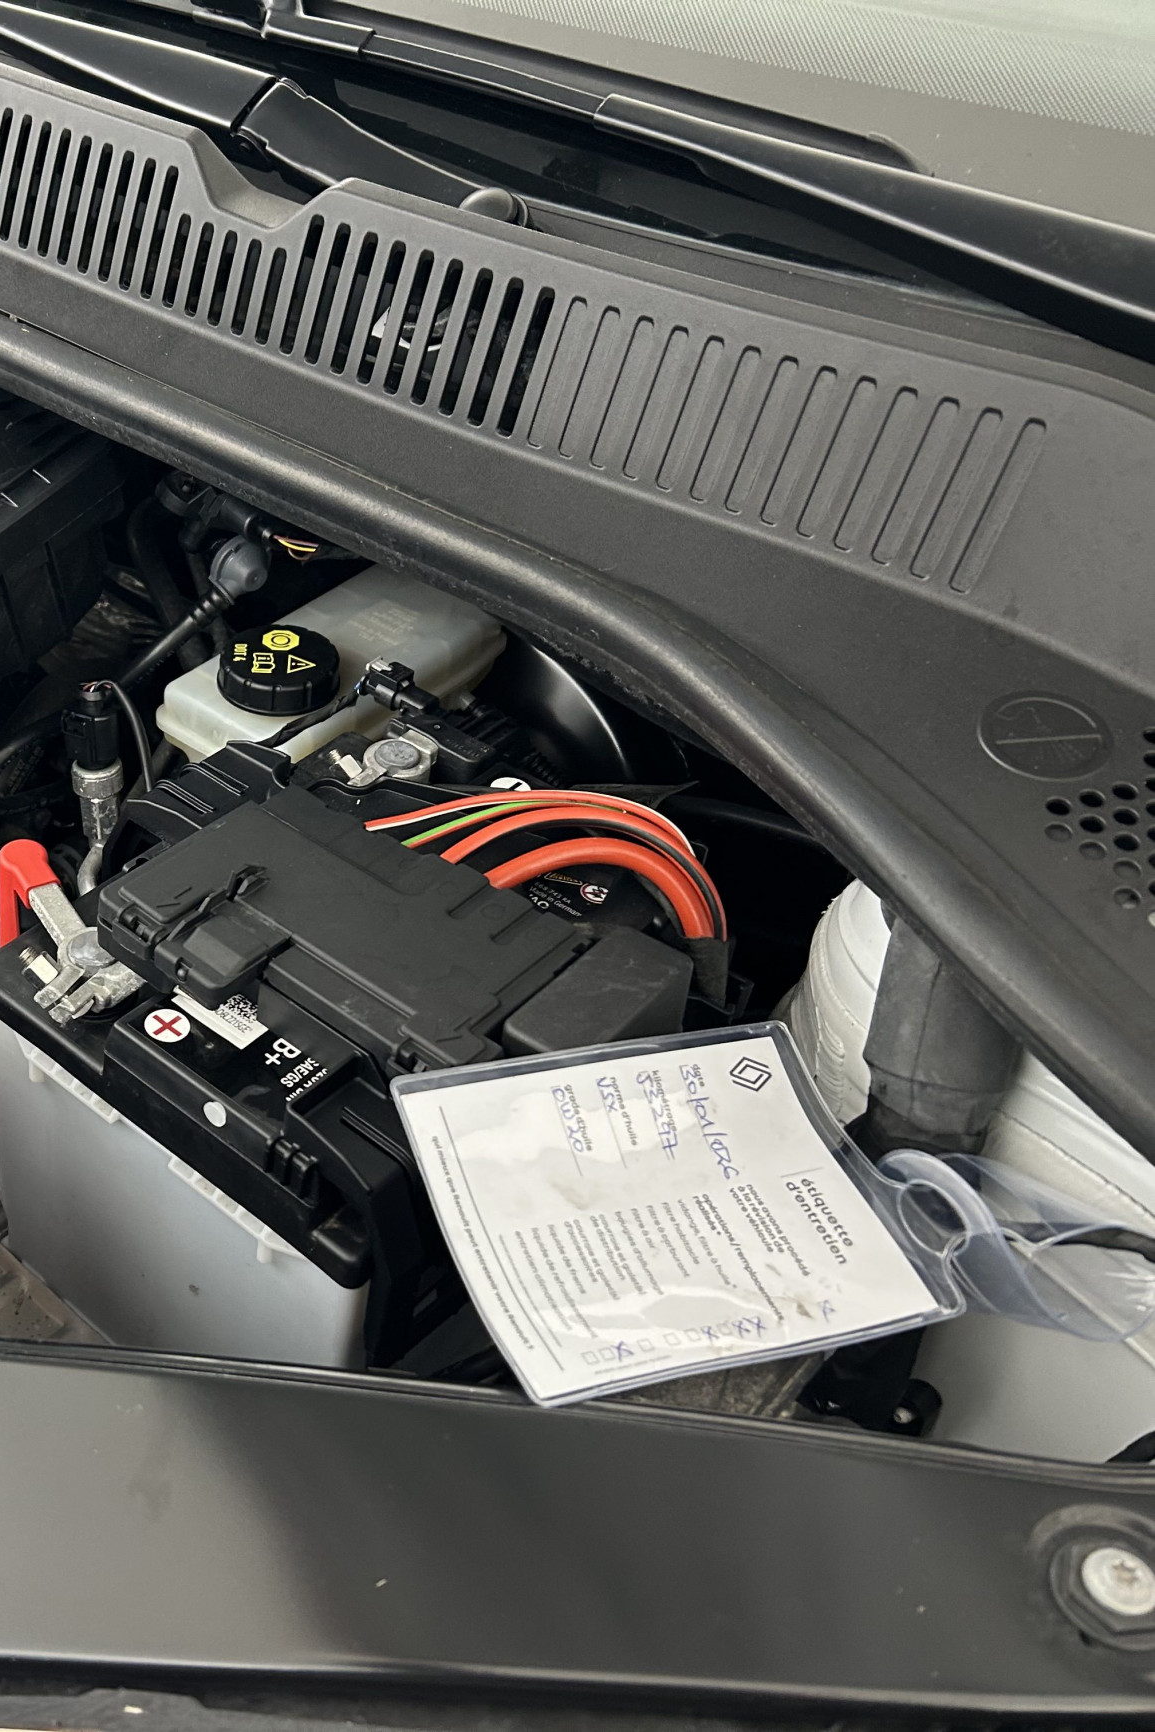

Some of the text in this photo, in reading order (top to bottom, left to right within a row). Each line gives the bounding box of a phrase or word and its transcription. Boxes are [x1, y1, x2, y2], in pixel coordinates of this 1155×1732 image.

[280, 1057, 320, 1088] SAE/GS
[629, 1207, 646, 1229] filtre
[644, 1204, 662, 1226] filtre
[728, 1187, 749, 1212] votre
[784, 1180, 850, 1265] d'entretien
[799, 1177, 854, 1247] étiquette
[660, 1201, 701, 1265] filtre habitacle
[745, 1183, 811, 1276] nous avons procédé
[747, 1202, 778, 1239] révision
[772, 1240, 786, 1253] de
